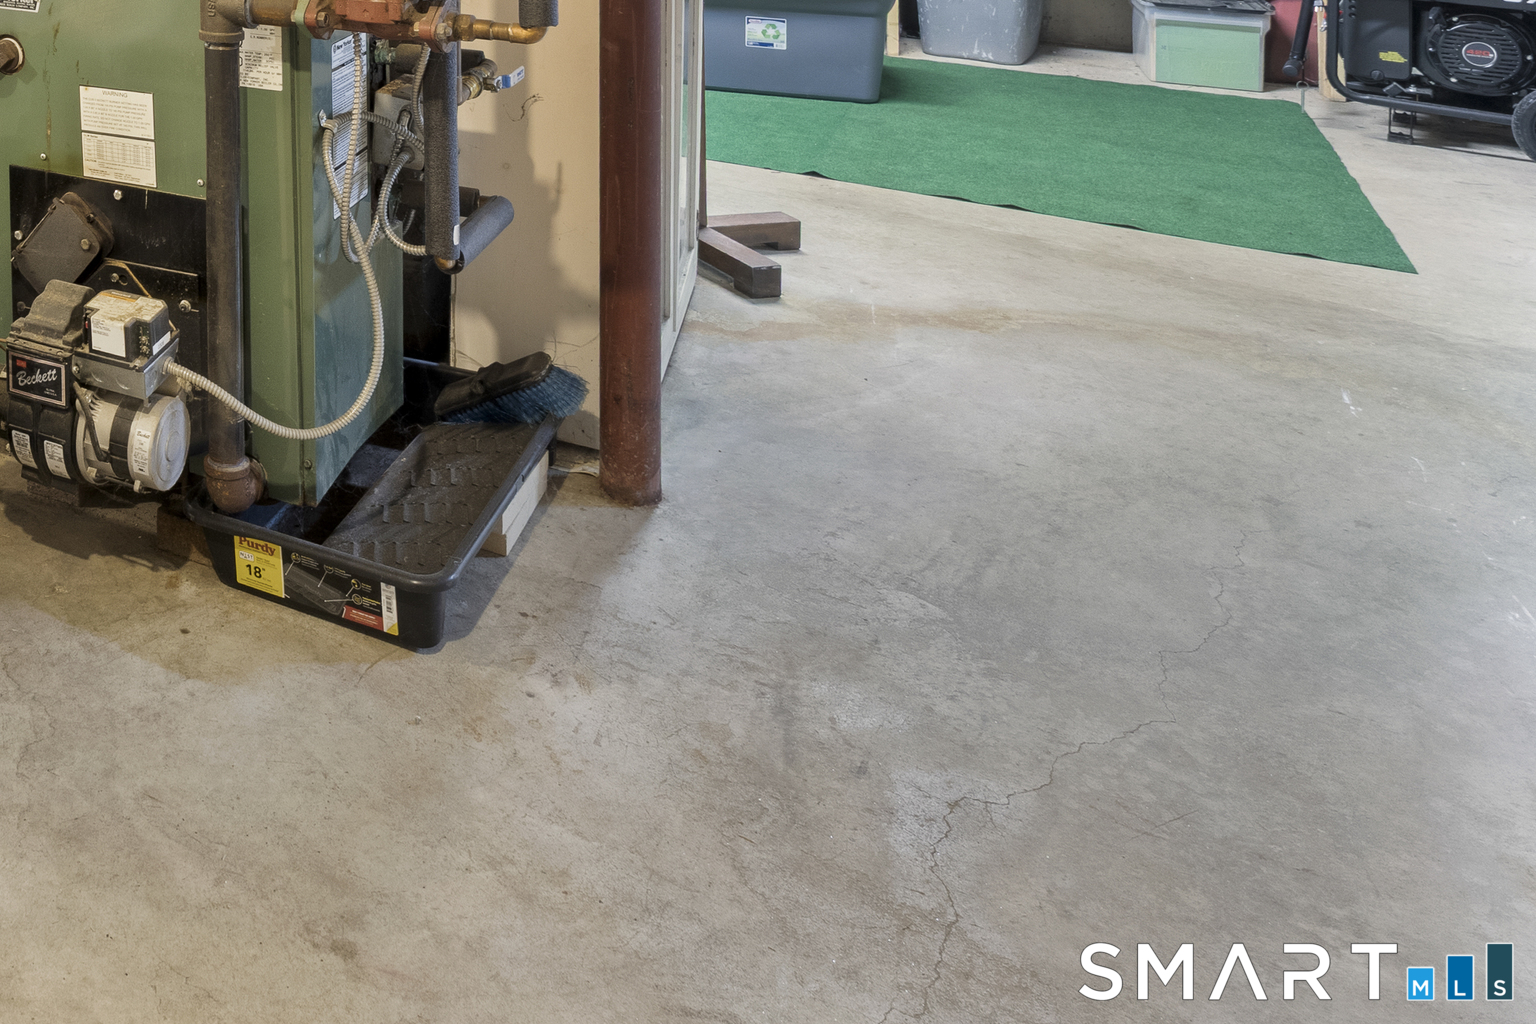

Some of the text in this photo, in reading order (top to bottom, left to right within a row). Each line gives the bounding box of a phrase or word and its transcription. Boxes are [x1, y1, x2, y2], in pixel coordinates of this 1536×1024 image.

[102, 90, 128, 98] WARNING
[16, 368, 58, 387] Beckett
[238, 536, 276, 556] Purdy
